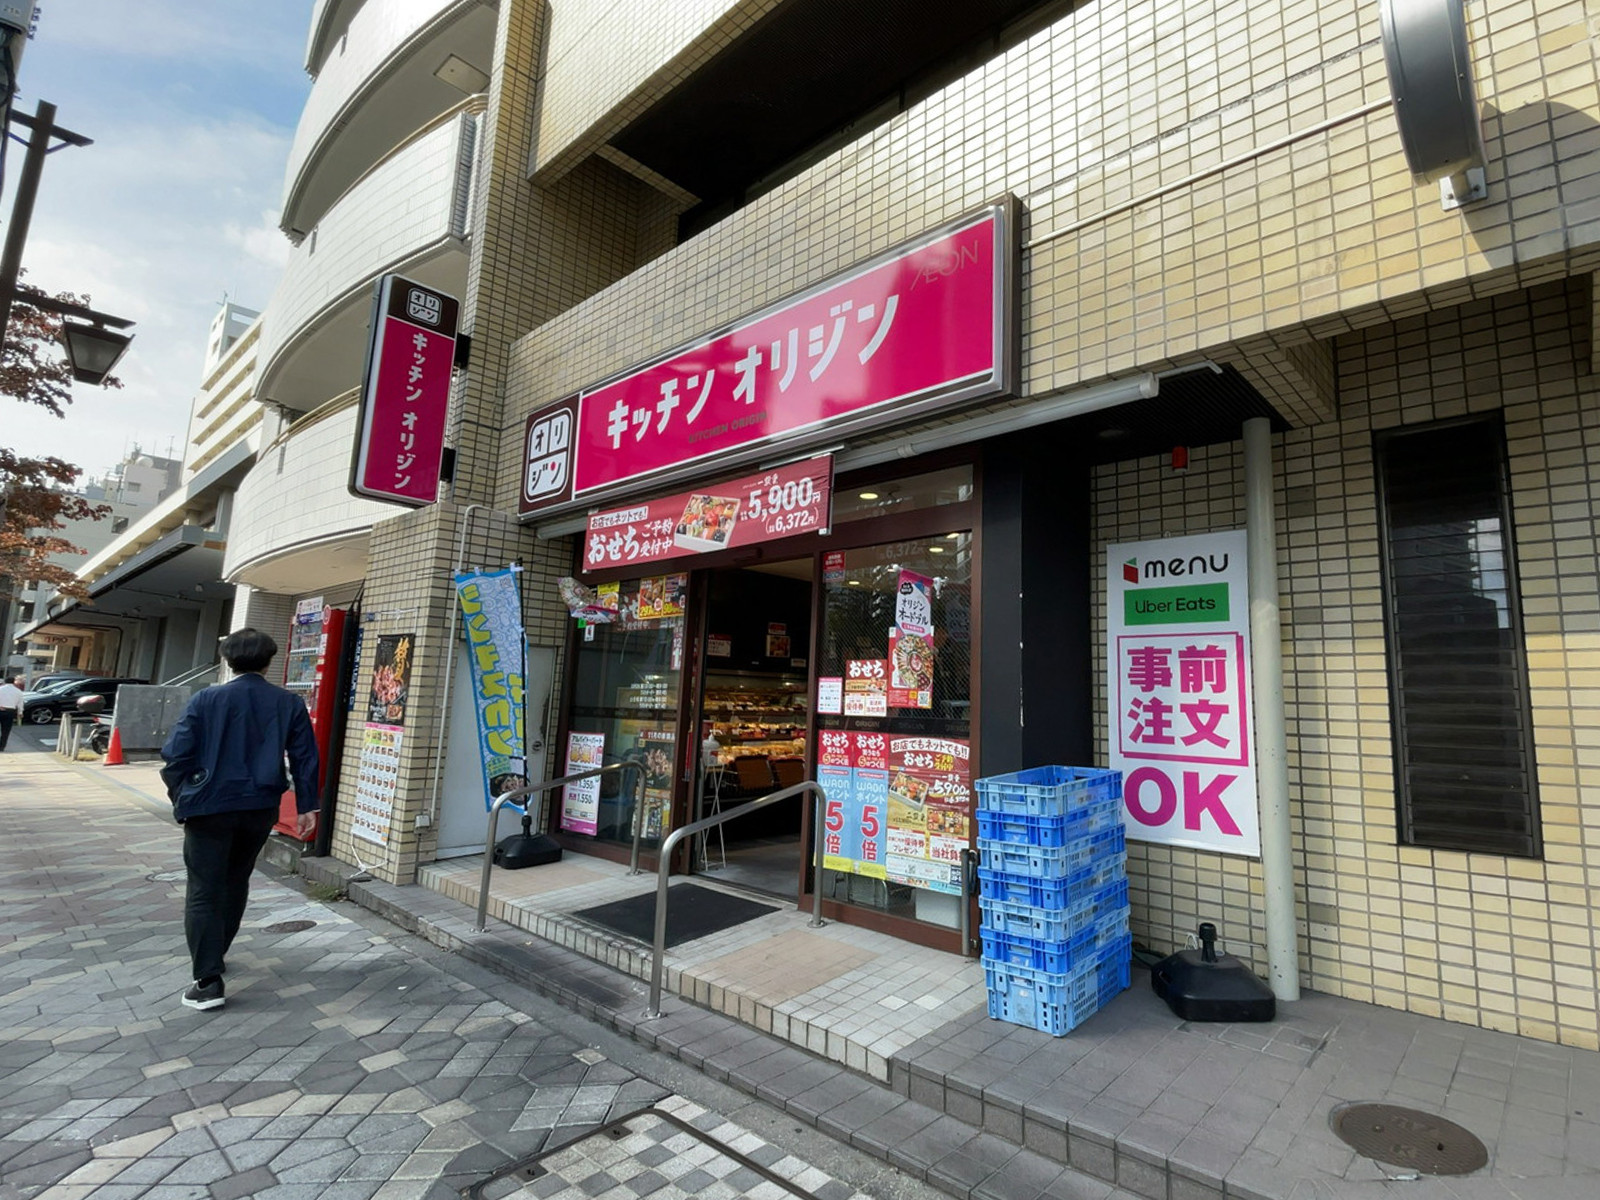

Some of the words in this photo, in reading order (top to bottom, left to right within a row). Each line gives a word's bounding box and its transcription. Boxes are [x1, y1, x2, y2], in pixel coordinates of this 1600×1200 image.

[405, 331, 430, 402] キッチン
[607, 369, 715, 450] キッチン
[732, 294, 899, 405] オリジン
[689, 423, 729, 444] KITCHEN
[731, 410, 768, 430] ORIGIN
[393, 411, 419, 490] オリジン
[588, 525, 640, 564] おせち
[640, 537, 673, 557] 受付中
[1145, 553, 1229, 579] menu
[1135, 598, 1172, 615] Uber
[1175, 597, 1216, 612] Eats
[850, 660, 885, 678] おせち
[1127, 645, 1228, 694] 事前
[1127, 697, 1231, 749] 注文
[822, 732, 849, 748] おせち
[856, 734, 885, 750] おせち
[903, 752, 934, 769] おせち
[1123, 766, 1244, 837] OK
[861, 806, 879, 838] 5
[862, 840, 877, 861] 倍
[932, 847, 961, 861] 当社負
